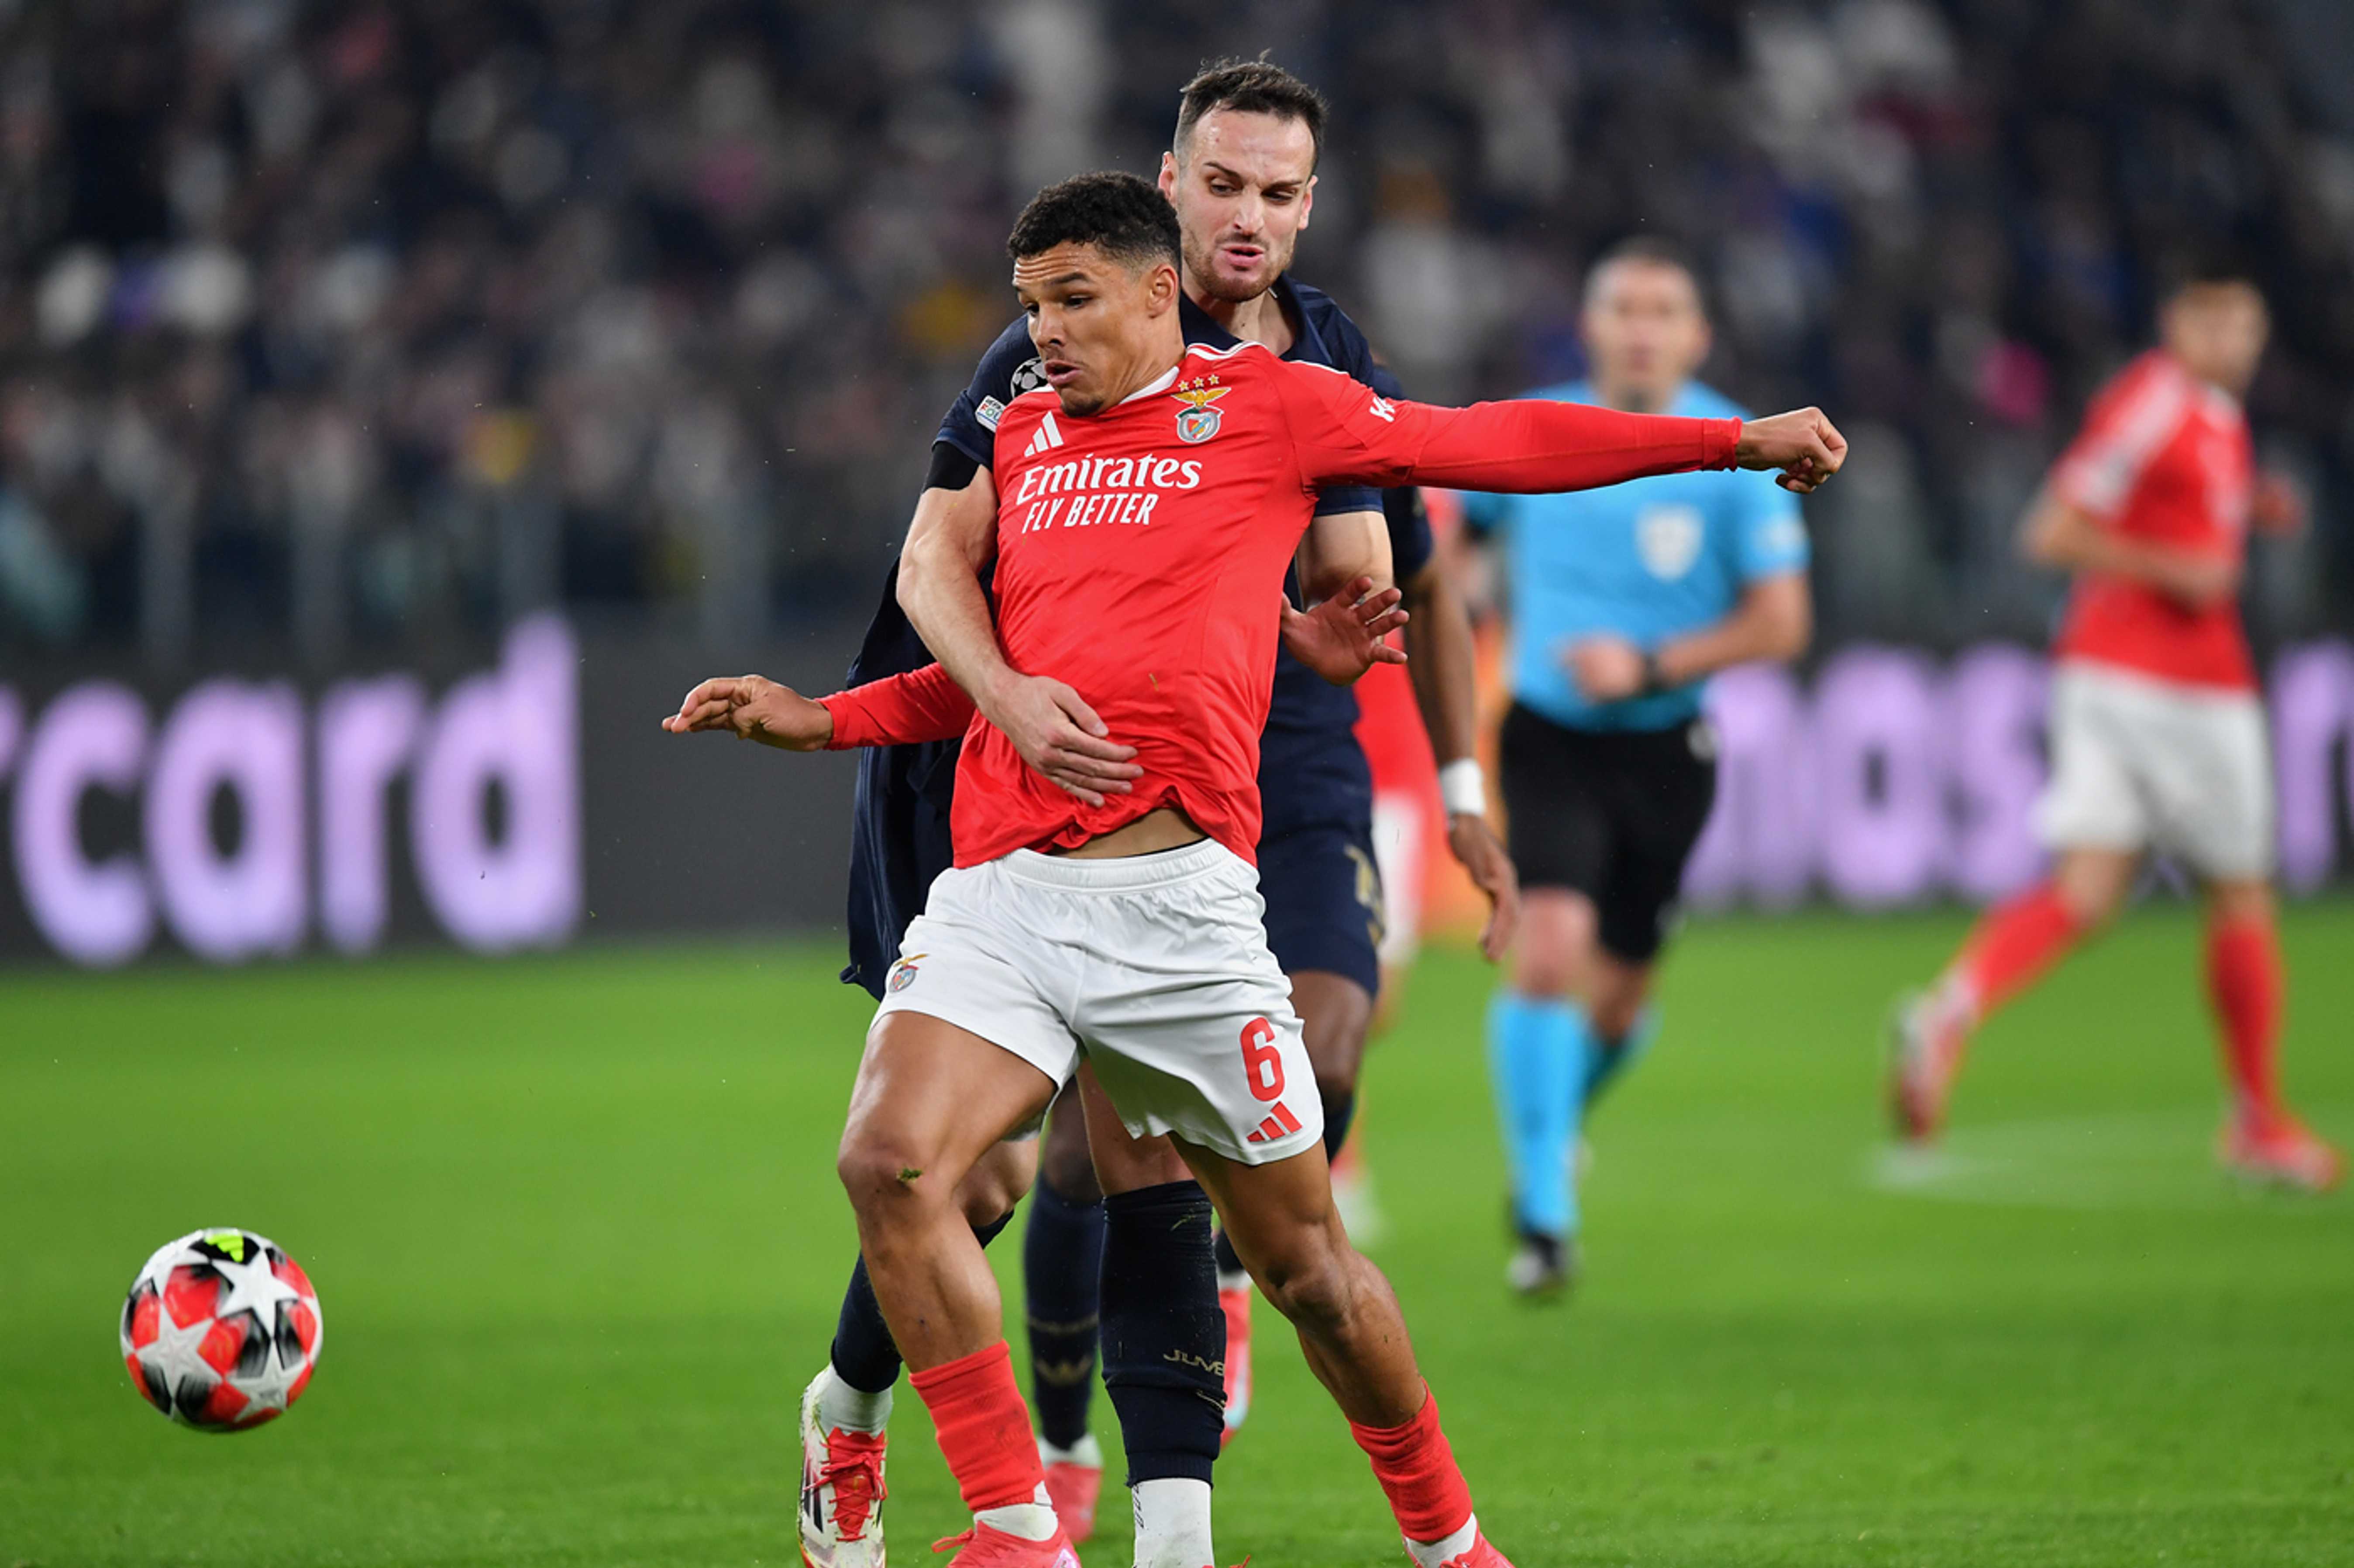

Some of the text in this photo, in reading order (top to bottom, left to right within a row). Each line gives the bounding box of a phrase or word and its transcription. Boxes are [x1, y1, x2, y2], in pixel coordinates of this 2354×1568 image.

[1016, 453, 1203, 505] Emirates
[1022, 493, 1159, 534] FLY BETTER
[0, 615, 582, 964] card
[1239, 1017, 1285, 1102] 6
